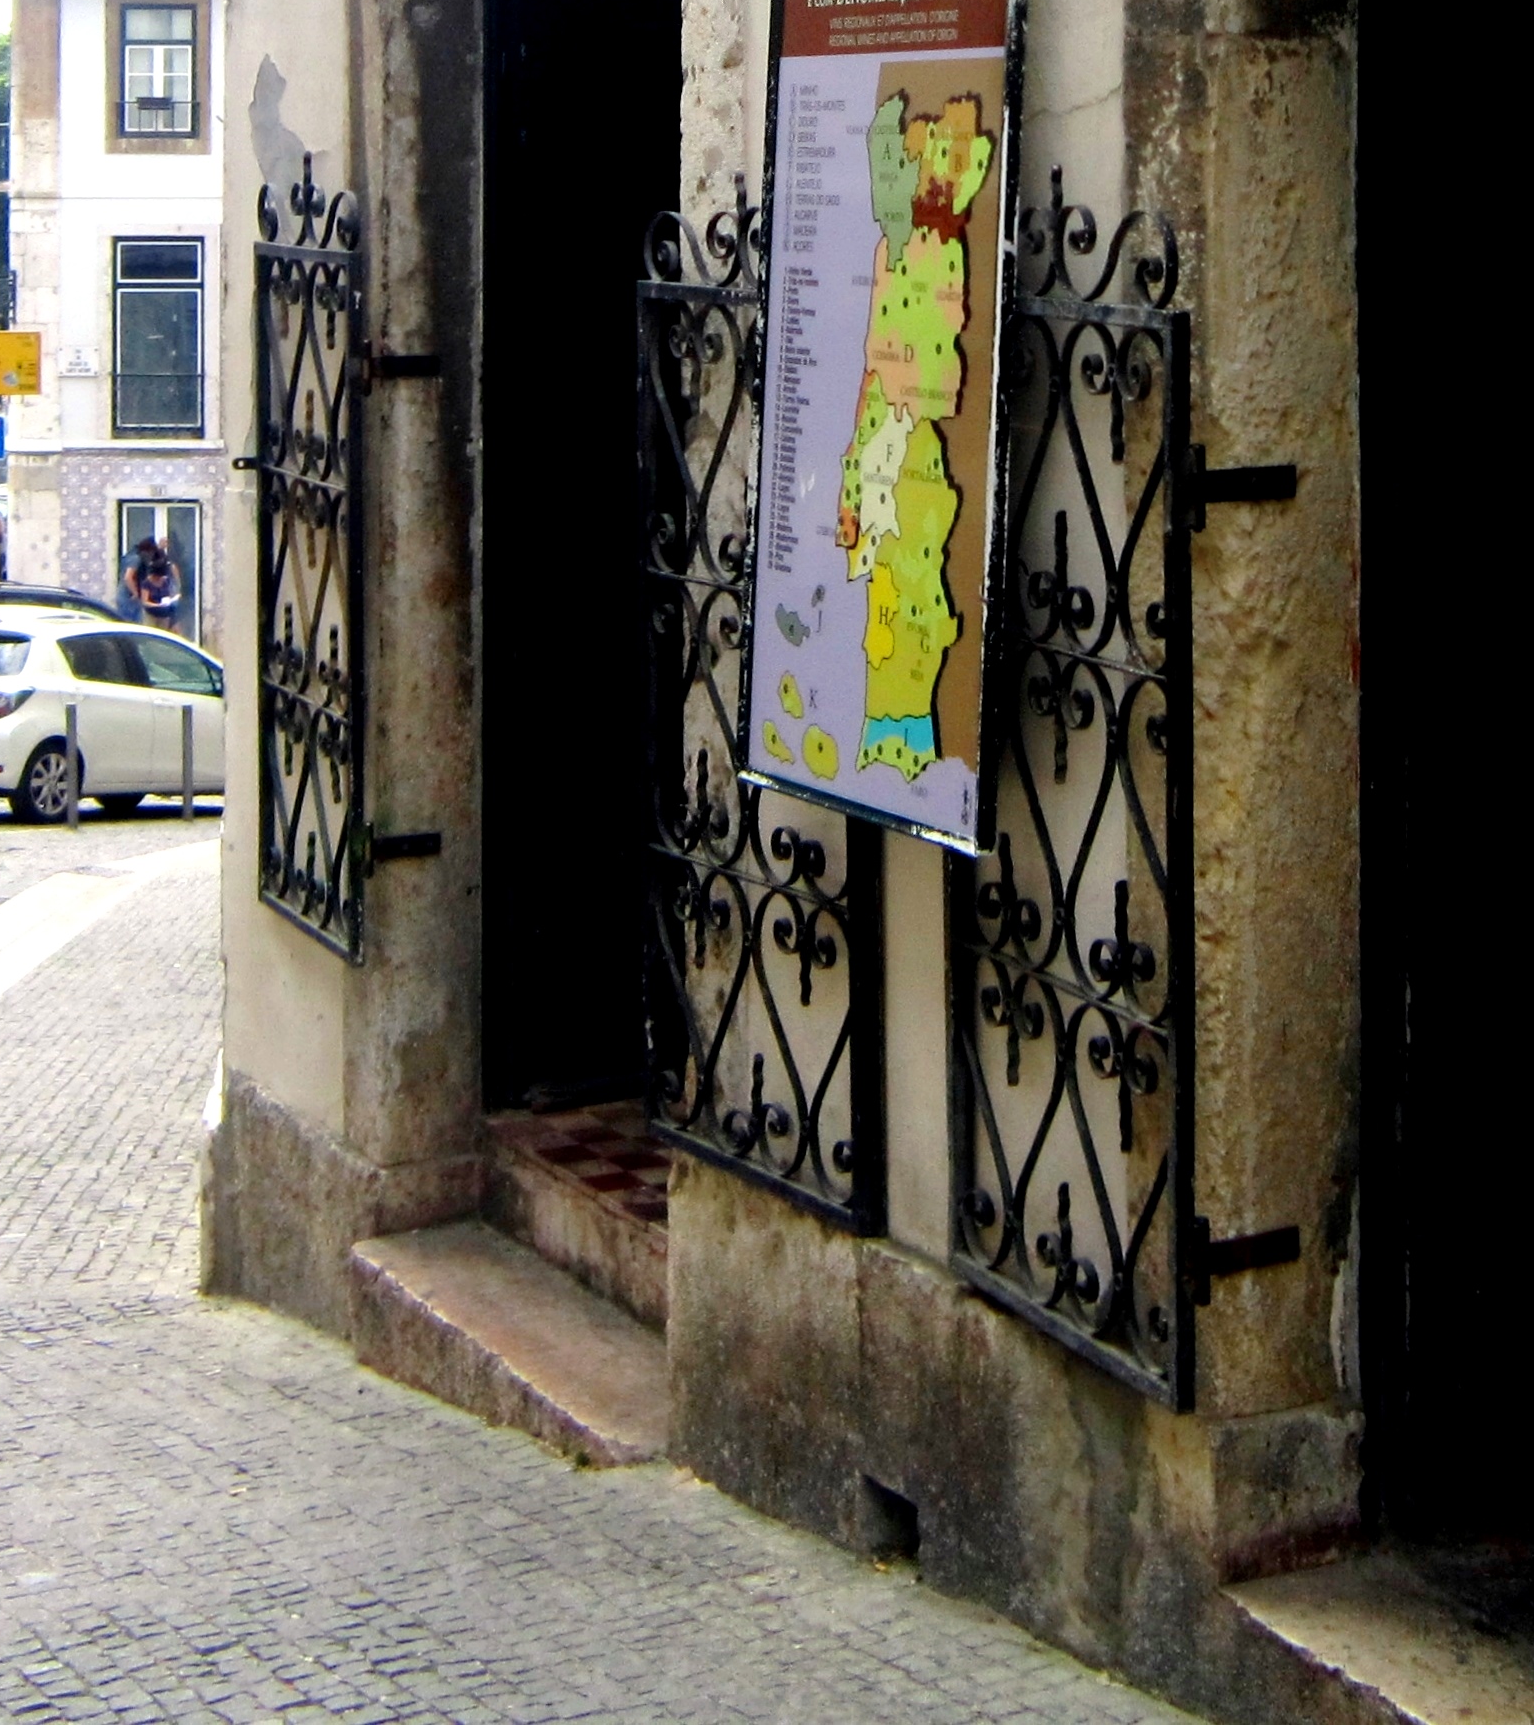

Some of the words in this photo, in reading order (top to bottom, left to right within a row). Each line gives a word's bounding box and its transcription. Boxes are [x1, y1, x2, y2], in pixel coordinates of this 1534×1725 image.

[903, 343, 914, 363] D
[886, 443, 894, 463] F
[878, 605, 890, 626] H
[920, 635, 931, 655] G
